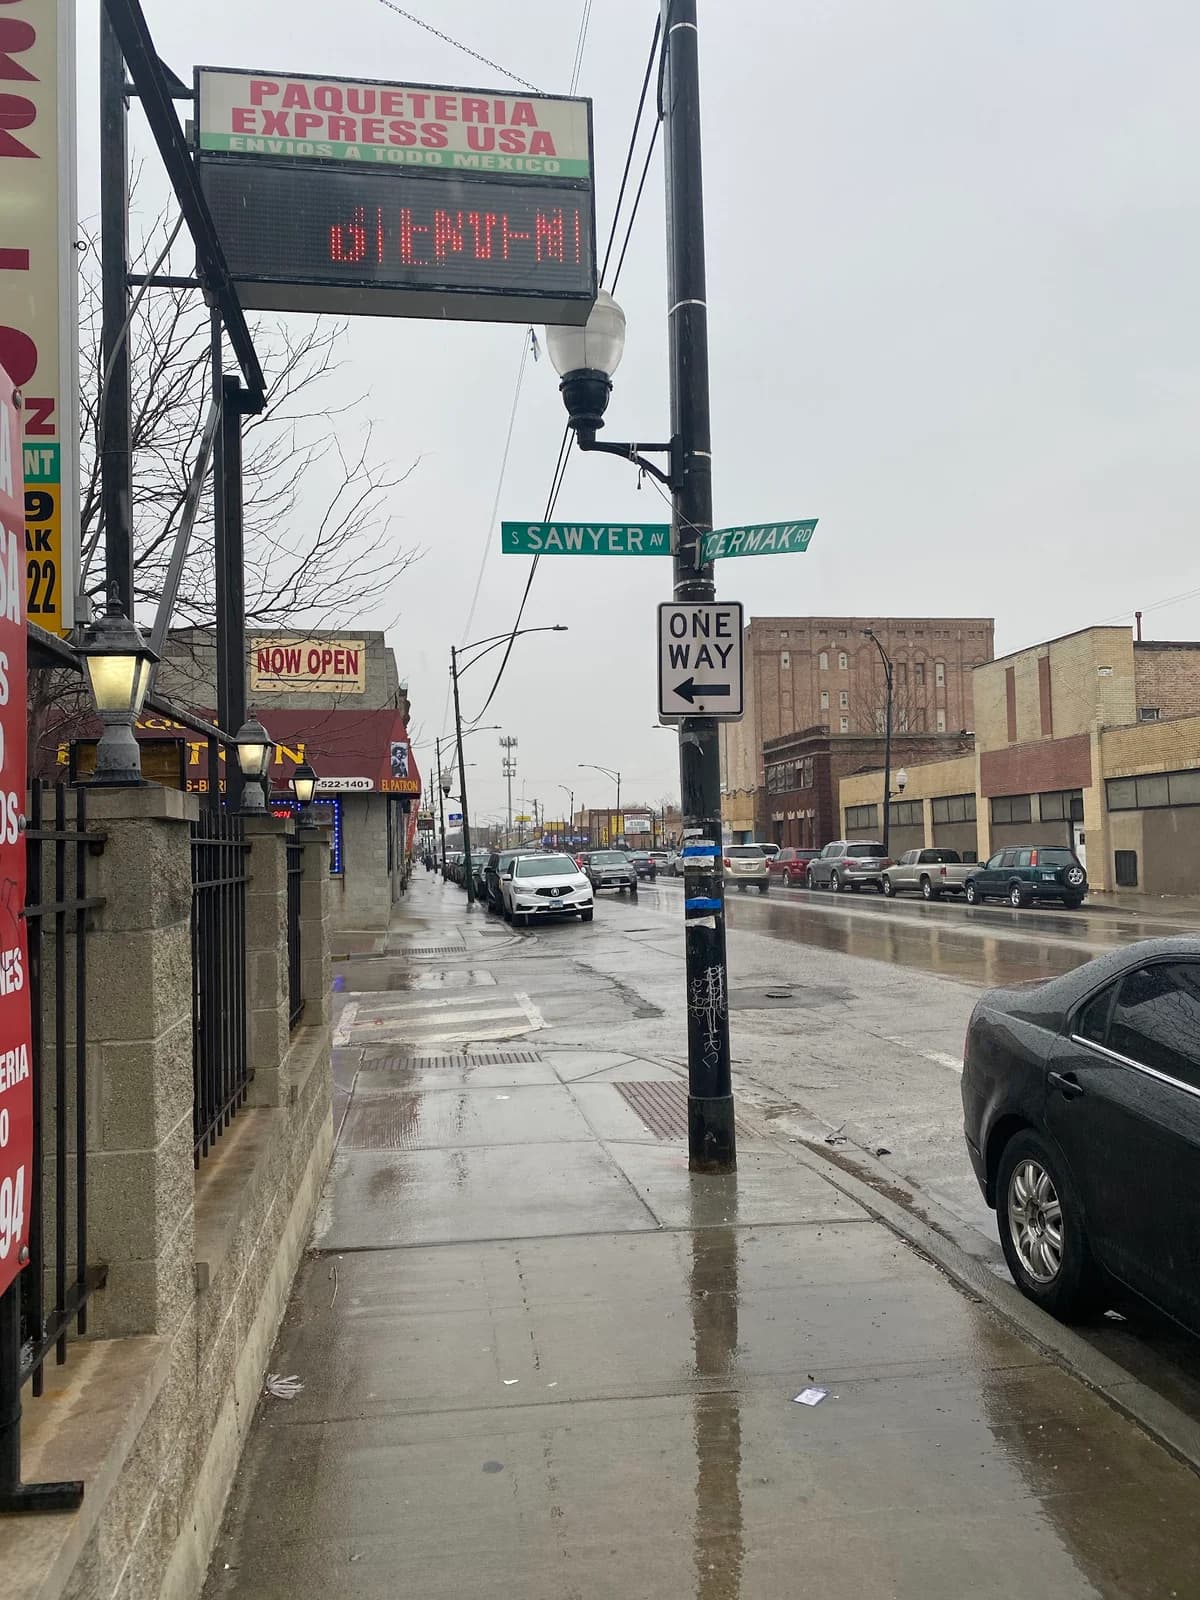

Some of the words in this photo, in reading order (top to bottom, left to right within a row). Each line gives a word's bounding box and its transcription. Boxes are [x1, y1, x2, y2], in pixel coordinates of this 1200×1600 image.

[250, 80, 538, 127] PAQUETERIA
[232, 107, 449, 148] EXPRESS
[467, 126, 557, 156] USA
[229, 137, 333, 157] ENVIOS
[344, 146, 361, 161] A
[372, 148, 443, 165] TODO
[453, 153, 561, 173] MEXICO
[511, 531, 520, 545] S
[527, 526, 644, 551] SAWYER
[650, 533, 664, 546] AV
[706, 525, 799, 556] CERMAK
[795, 528, 812, 543] RD
[670, 612, 732, 638] ONE
[257, 648, 301, 674] NOW
[307, 649, 358, 675] OPEN
[669, 644, 734, 669] WAY
